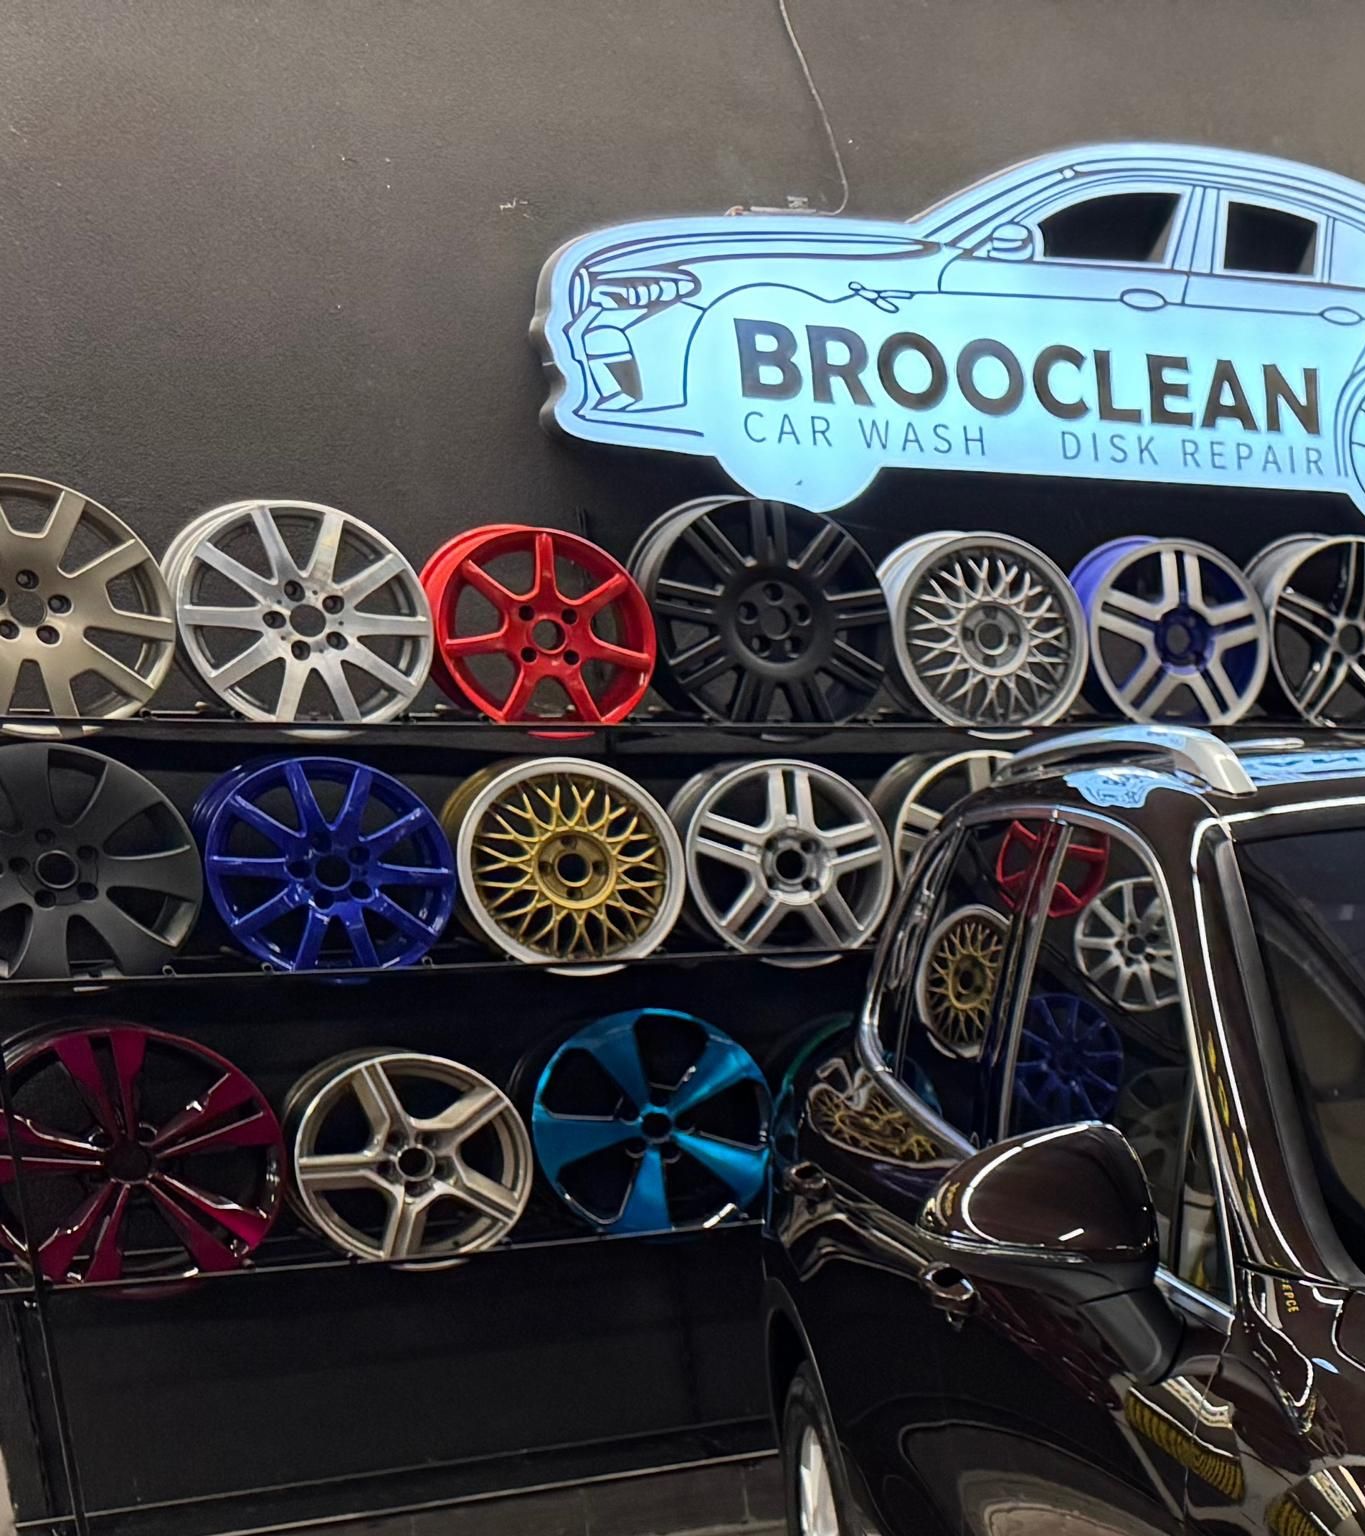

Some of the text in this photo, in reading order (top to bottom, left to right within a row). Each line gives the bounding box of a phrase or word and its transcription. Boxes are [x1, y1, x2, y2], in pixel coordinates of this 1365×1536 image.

[733, 317, 1322, 436] BROOCLEAN
[743, 411, 1324, 475] CAR WASH DISK REPAIR
